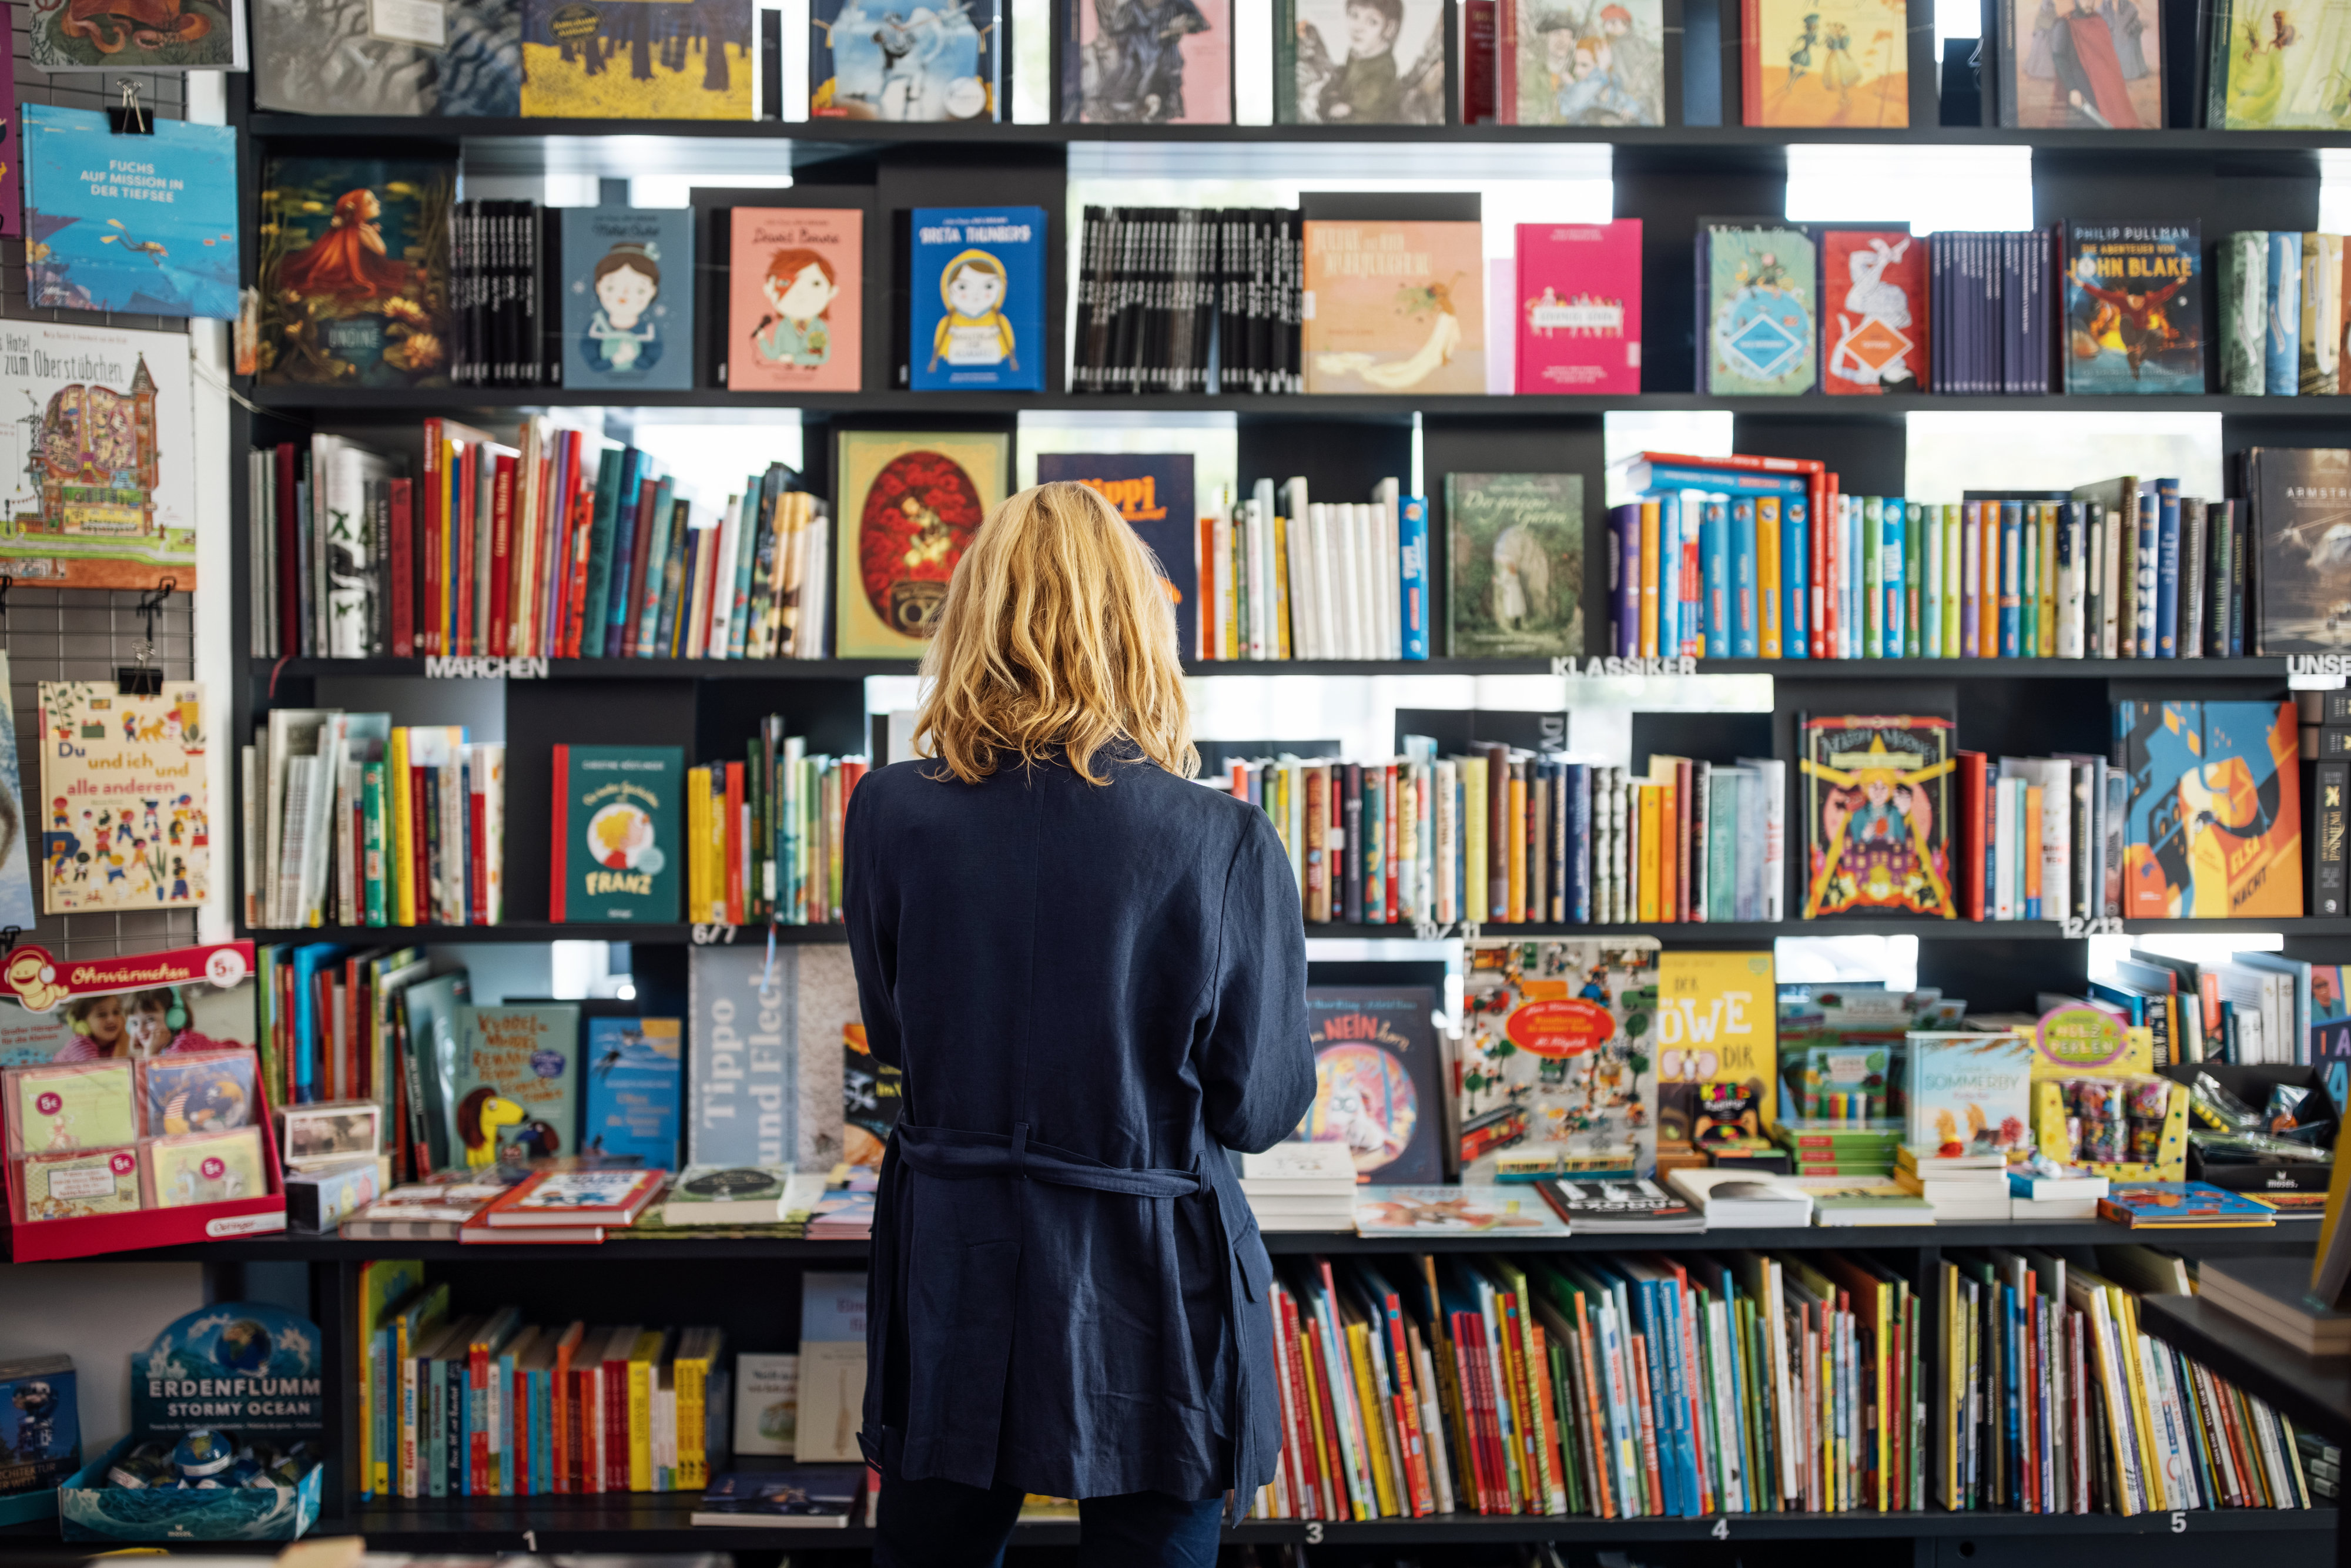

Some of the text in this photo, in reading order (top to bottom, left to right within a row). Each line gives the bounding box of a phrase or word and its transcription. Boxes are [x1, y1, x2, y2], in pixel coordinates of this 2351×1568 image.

[110, 160, 155, 175] FUCHS
[80, 170, 184, 191] AUF MISSION IN
[91, 184, 175, 203] DER TIEFSEE
[2074, 226, 2190, 242] PHILIP PULLMAN
[2081, 243, 2176, 255] DIE ABENTEUER VON
[2070, 256, 2193, 278] JOHN BLAKE
[6, 333, 31, 354] Hotel
[4, 348, 124, 384] zum Oberstübchen
[2286, 486, 2351, 499] ARMSTR
[1550, 655, 1698, 678] KLASSIKER
[58, 742, 86, 758] Du
[88, 751, 189, 778] und ich und
[66, 776, 176, 796] alle anderen
[2230, 834, 2262, 877] ELSA
[585, 871, 654, 896] FRANZ
[2232, 865, 2268, 912] NACHT
[692, 923, 738, 944] 6/7
[2059, 917, 2124, 939] 12/13
[71, 962, 191, 986] Ohrwürmchen
[1657, 990, 1753, 1044] ÖWE
[703, 999, 745, 1131] Tippo
[748, 959, 782, 1074] Fleck
[2050, 1039, 2114, 1055] PERLEN
[1925, 1074, 2021, 1092] SOMMERBY
[41, 1095, 58, 1110] 5€
[113, 1157, 130, 1171] 5€
[168, 1401, 312, 1417] STORMY OCEAN
[2151, 1399, 2166, 1441] FREUNDE
[1305, 1521, 1324, 1544] 3
[1711, 1517, 1730, 1541] 4
[2171, 1511, 2187, 1533] 5
[523, 1529, 538, 1552] 1
